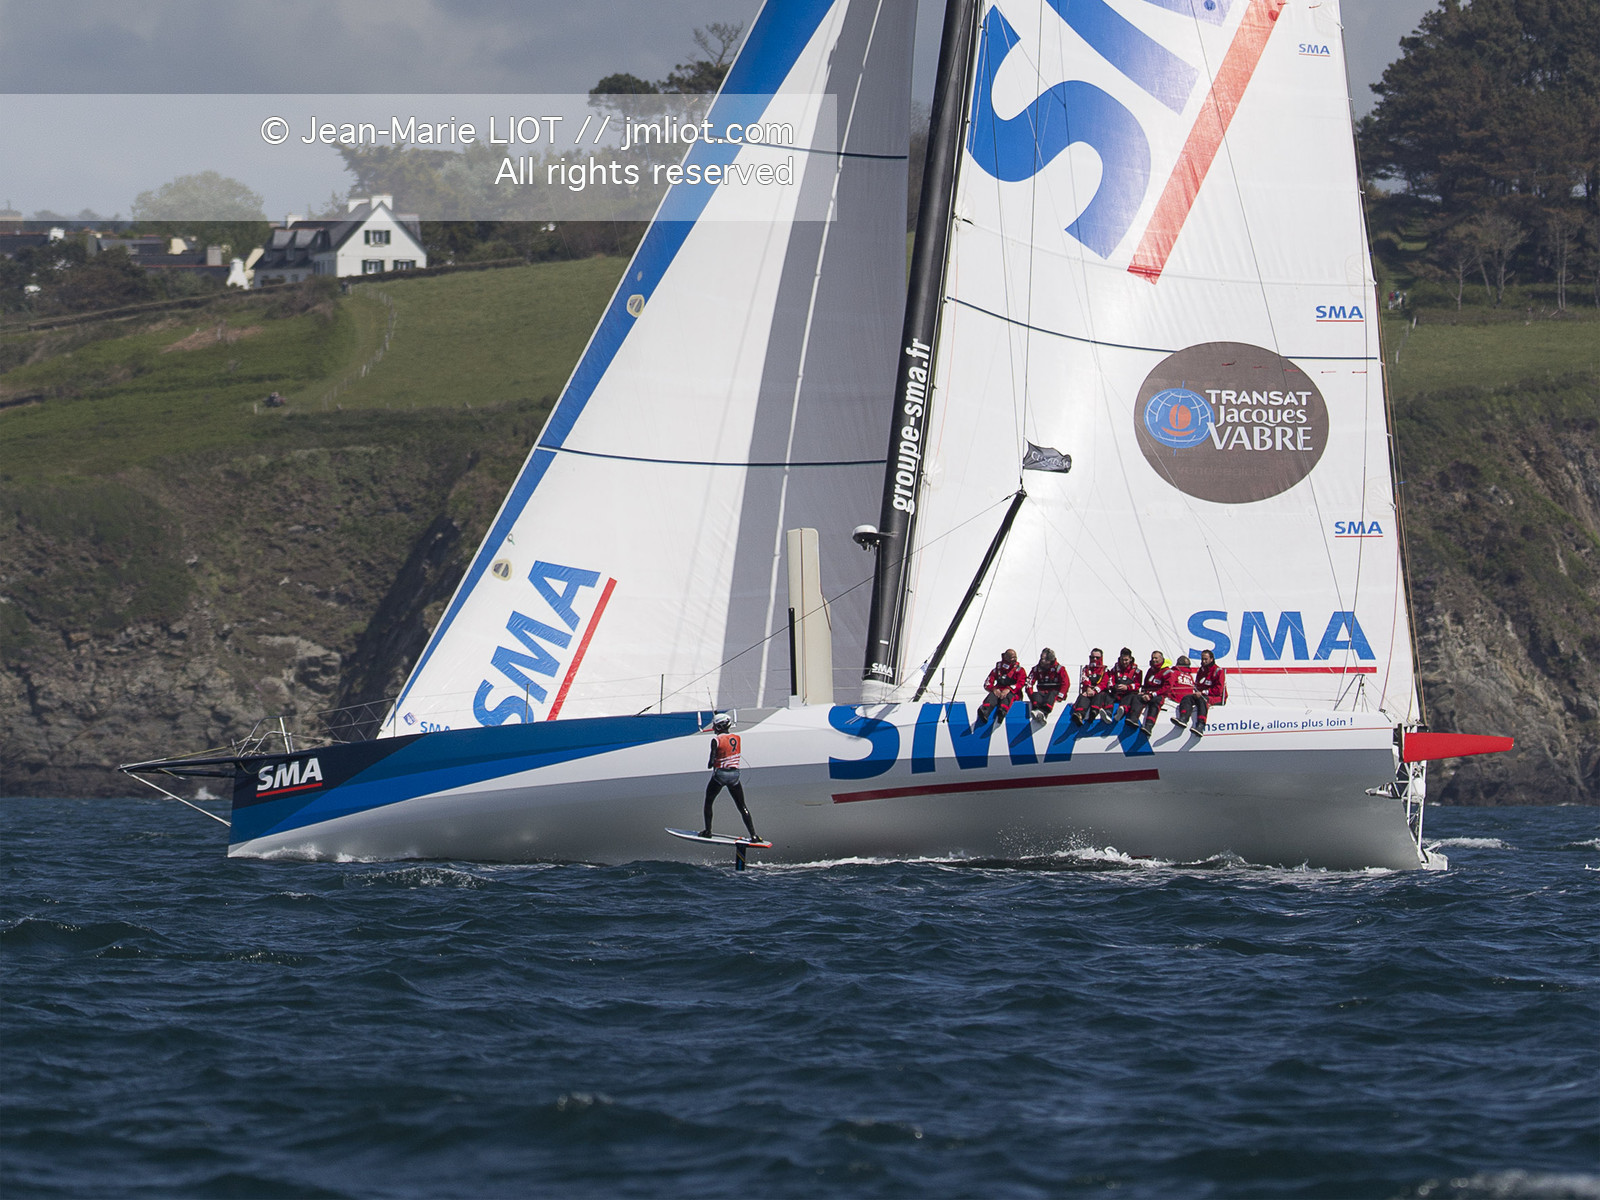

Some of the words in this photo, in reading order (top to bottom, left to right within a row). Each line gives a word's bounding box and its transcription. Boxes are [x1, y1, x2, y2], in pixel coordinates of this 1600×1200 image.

[1298, 43, 1331, 55] SMA
[1315, 305, 1364, 319] SMA
[1205, 389, 1312, 406] TRANSAT
[1215, 405, 1307, 427] Jacques
[892, 337, 931, 516] groupe-sma.fr
[1206, 422, 1313, 451] VABRE
[1334, 521, 1384, 535] SMA
[473, 560, 602, 727] SMA
[1187, 610, 1377, 661] SMA
[871, 662, 893, 676] SMA
[1203, 719, 1265, 732] nsemble,
[1267, 719, 1299, 730] allons
[1301, 718, 1324, 730] plus
[1326, 717, 1347, 727] loin
[729, 737, 738, 753] 9
[827, 701, 1156, 781] SMA
[256, 757, 324, 792] SMA
